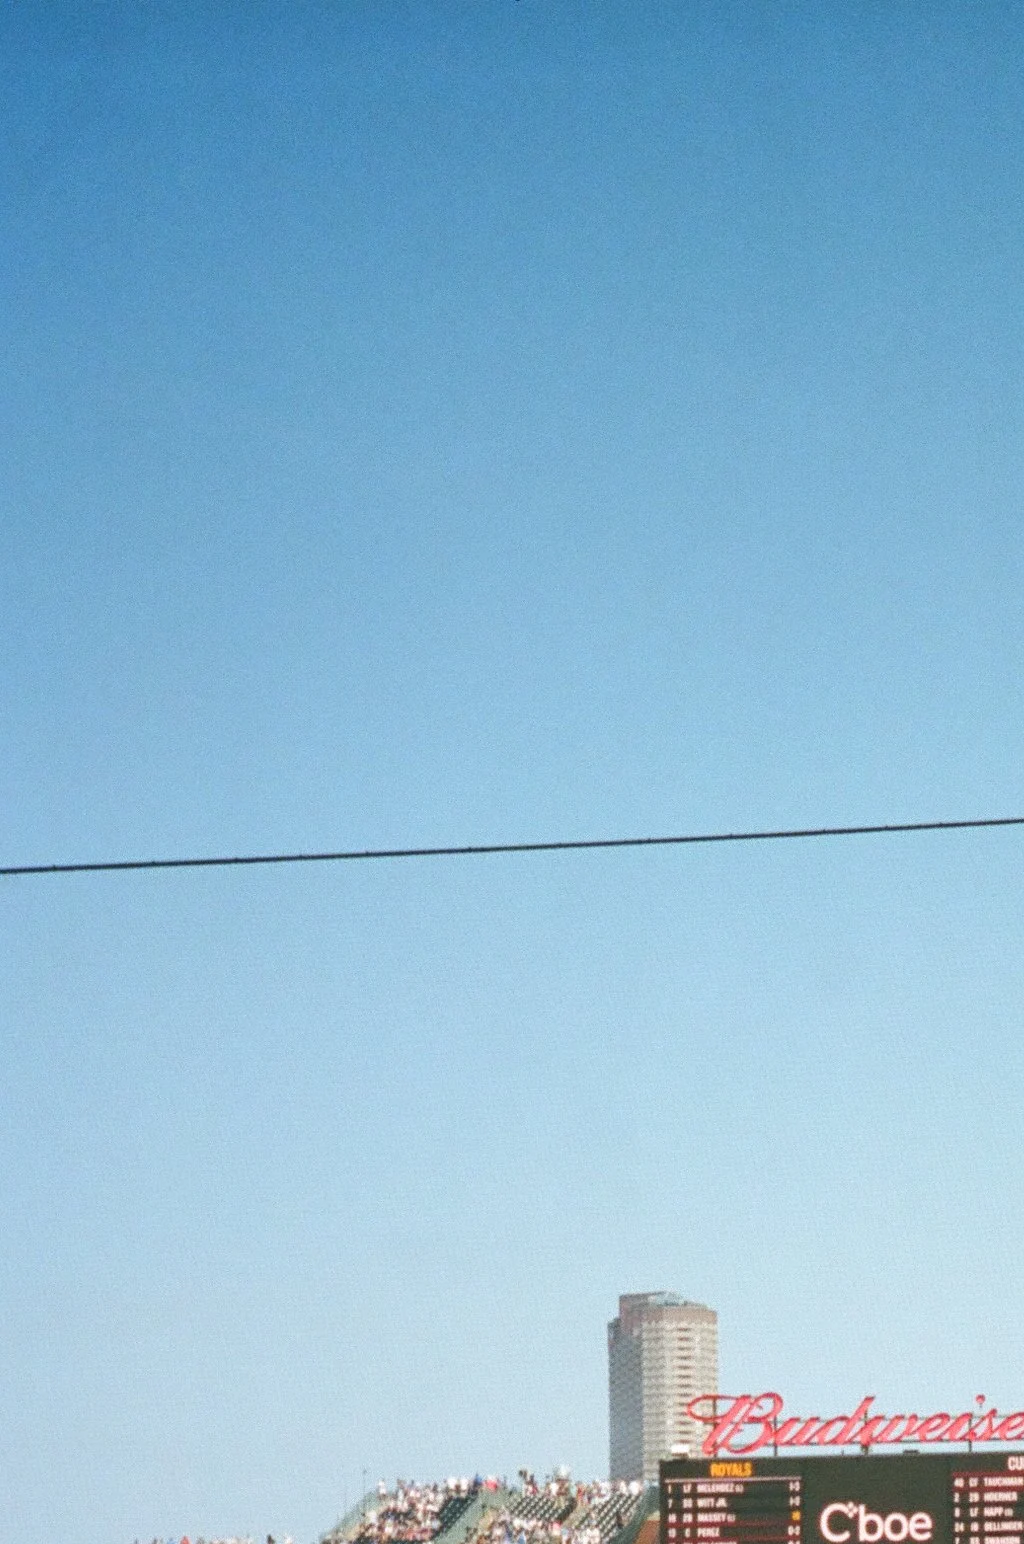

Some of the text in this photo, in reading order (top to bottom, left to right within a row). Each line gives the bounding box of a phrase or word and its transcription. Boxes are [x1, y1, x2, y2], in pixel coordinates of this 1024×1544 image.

[710, 1462, 752, 1477] ROYALS
[820, 1501, 933, 1543] Cboe
[697, 1527, 720, 1537] PEREZ
